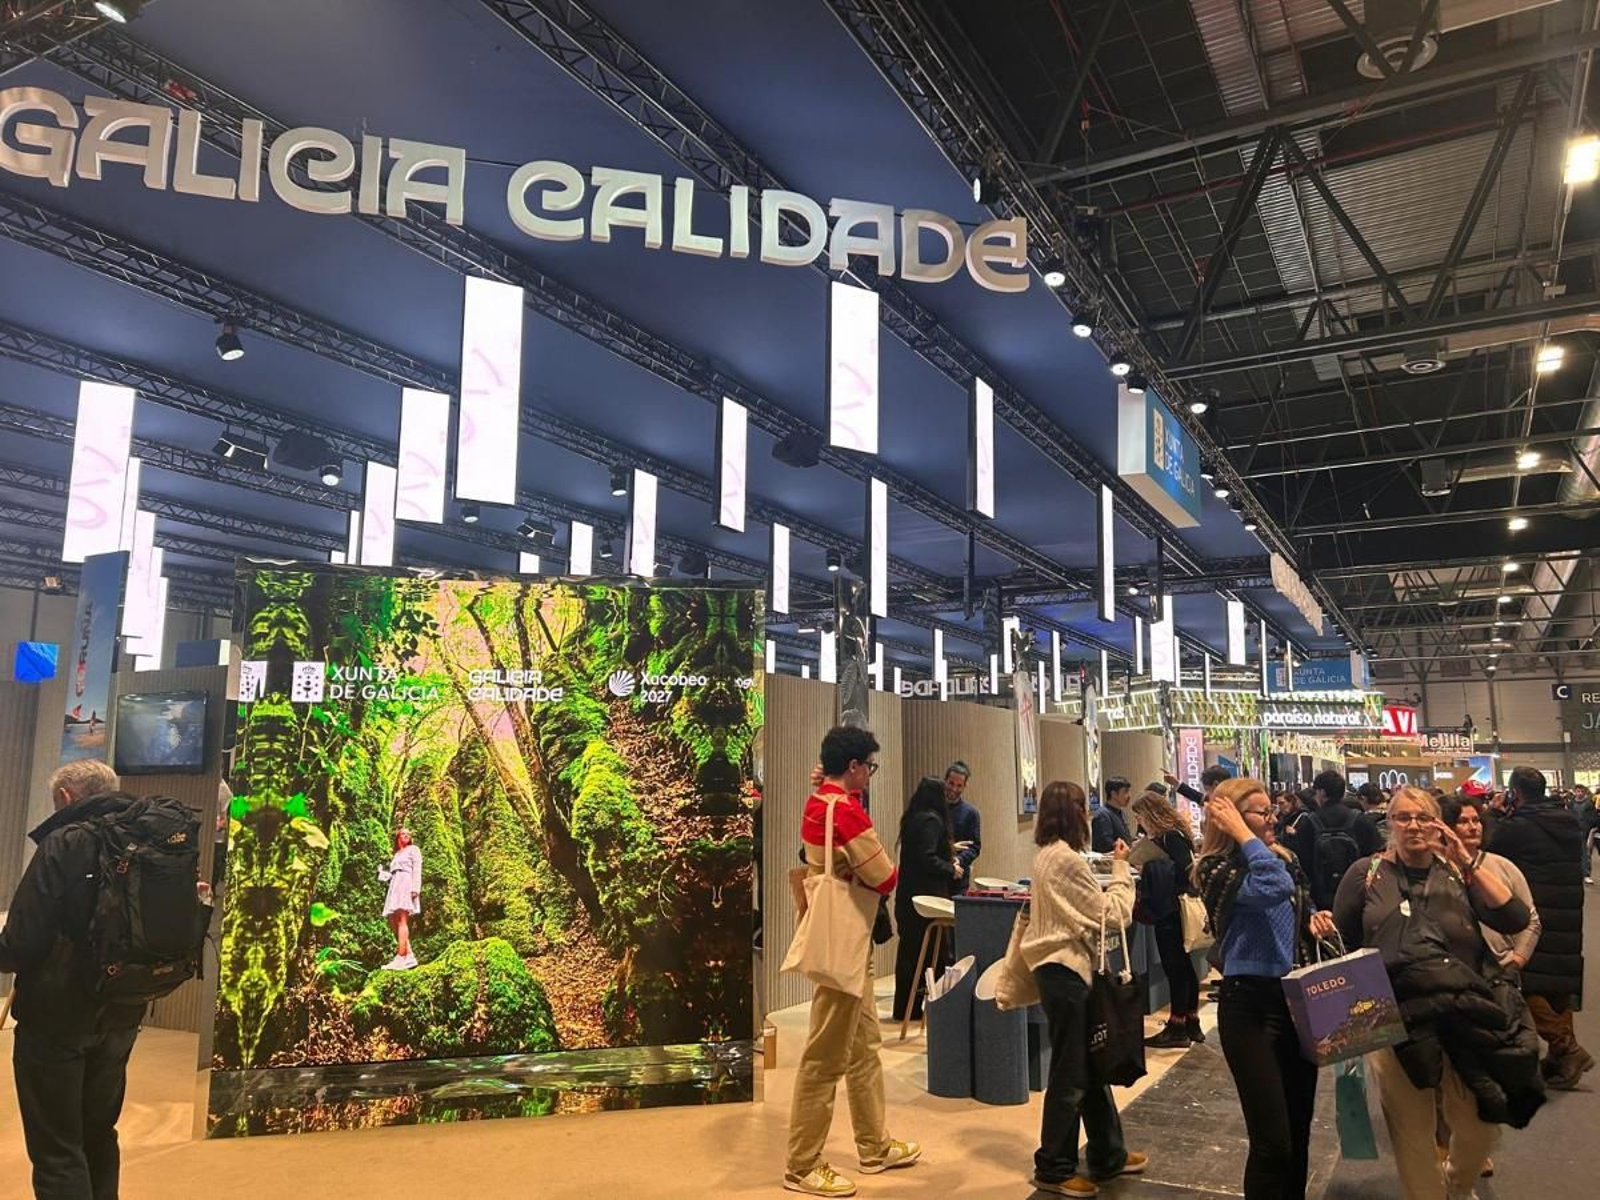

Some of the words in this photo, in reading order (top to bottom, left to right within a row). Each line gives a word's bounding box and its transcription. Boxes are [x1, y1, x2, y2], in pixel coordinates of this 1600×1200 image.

[0, 86, 466, 226] GALICIA
[507, 160, 1031, 293] CALIDADE
[331, 666, 397, 681] XUNTA
[469, 669, 542, 685] GALICIA
[641, 671, 707, 686] Xacobeo
[1308, 674, 1346, 684] GALICIA
[330, 685, 355, 699] DE
[361, 684, 439, 700] GALICIA
[467, 687, 563, 702] CALIDADE
[641, 690, 673, 703] 2027
[1556, 685, 1569, 699] C
[1314, 710, 1361, 725] natural
[1185, 736, 1199, 792] ALIDADE
[1306, 976, 1346, 996] TOLEDO
